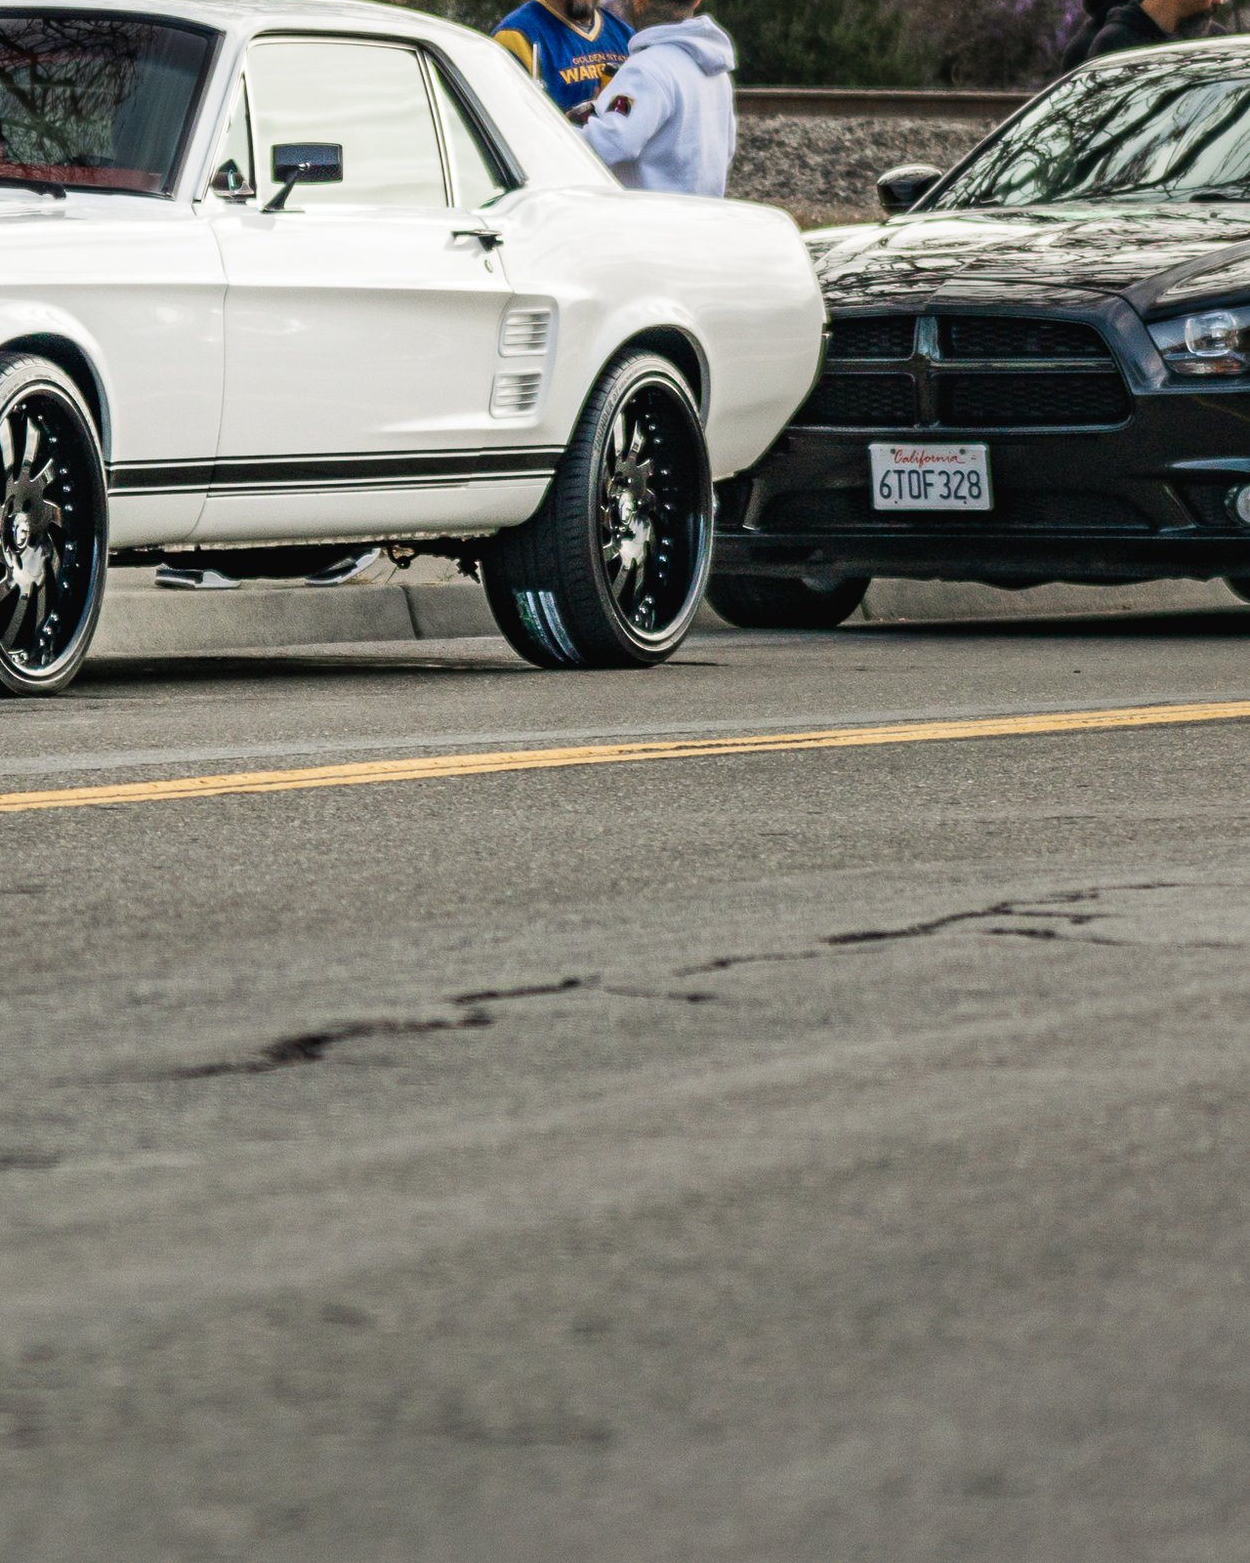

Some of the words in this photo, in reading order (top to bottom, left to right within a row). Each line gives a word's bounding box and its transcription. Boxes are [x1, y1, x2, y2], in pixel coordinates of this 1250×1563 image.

[572, 53, 606, 65] GOLDEN
[606, 53, 628, 62] STA
[894, 448, 966, 468] California
[879, 469, 982, 500] 6TOF328
